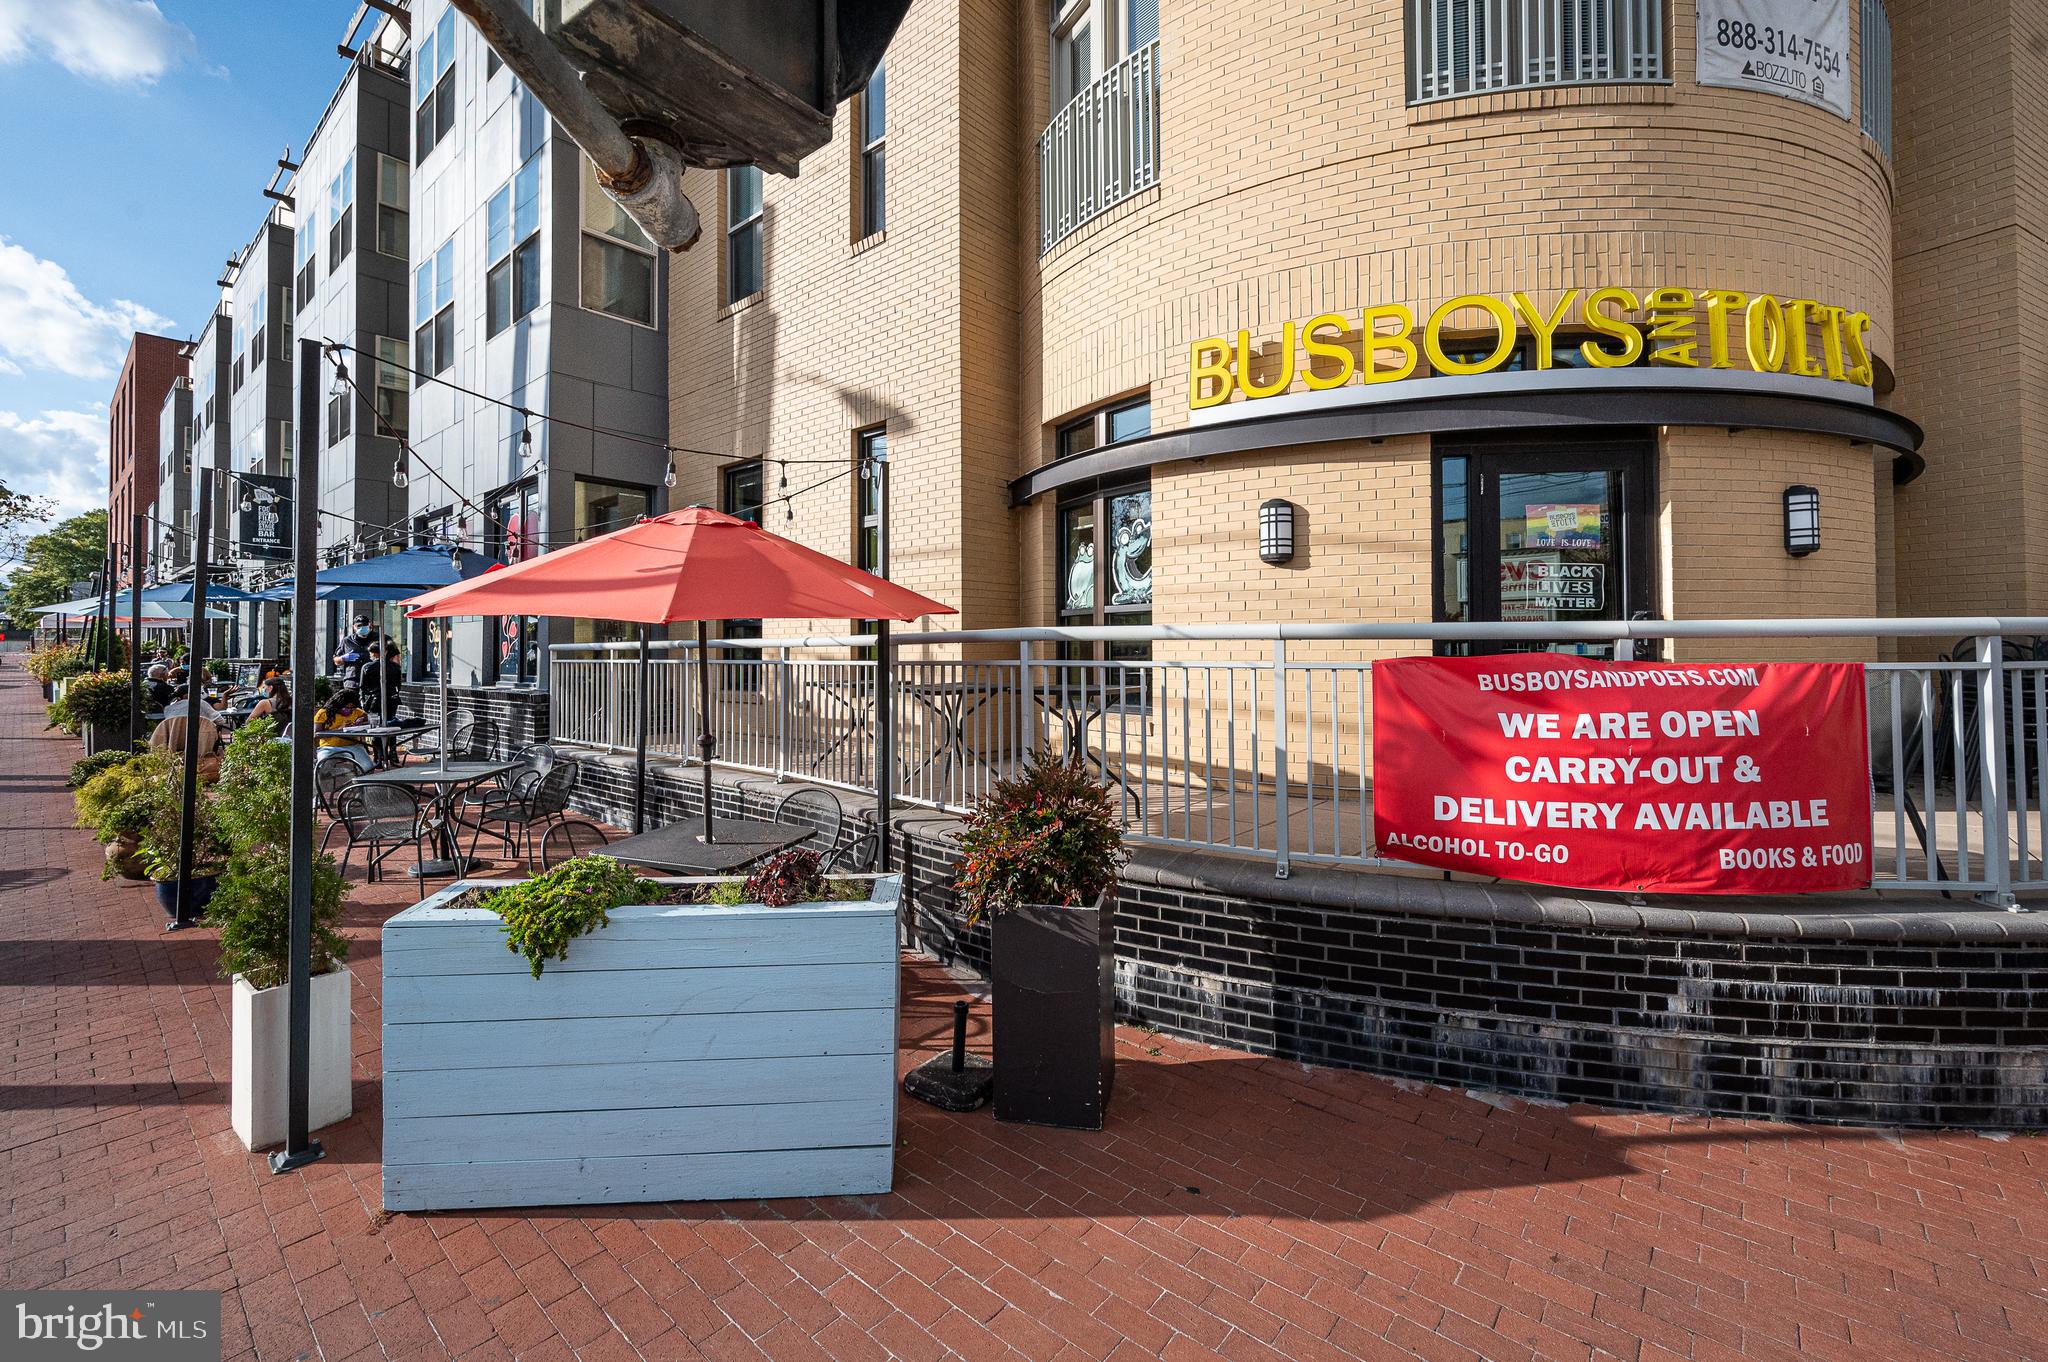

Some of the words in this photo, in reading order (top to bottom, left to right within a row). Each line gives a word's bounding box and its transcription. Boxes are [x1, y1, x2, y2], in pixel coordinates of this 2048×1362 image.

[1717, 18, 1841, 78] 888-314-7554
[1756, 61, 1806, 89] BOZZUTO
[1189, 287, 1643, 410] BUSBOYS
[1644, 287, 1699, 367] AND
[1698, 289, 1874, 387] POETS
[1536, 538, 1556, 547] LOVE
[1561, 538, 1570, 547] IS
[1572, 538, 1592, 547] LOVE
[1537, 565, 1595, 578] BLACK
[1537, 581, 1593, 594] LIVES
[1534, 597, 1596, 608] MATTER
[1477, 668, 1760, 692] BUSBOYSANDPOETS.COM
[1497, 712, 1561, 739] WE
[1572, 711, 1651, 740] ARE
[1660, 709, 1760, 738] OPEN
[1505, 756, 1723, 785] CARRY-OUT
[1733, 755, 1761, 783] &
[1433, 795, 1624, 830] DELIVERY
[1634, 799, 1829, 830] AVAILABLE
[1386, 832, 1491, 858] ALCOHOL
[1495, 841, 1569, 864] TO-GO
[1719, 847, 1796, 870] BOOKS
[1801, 846, 1817, 867] &
[1822, 842, 1863, 866] FOOD
